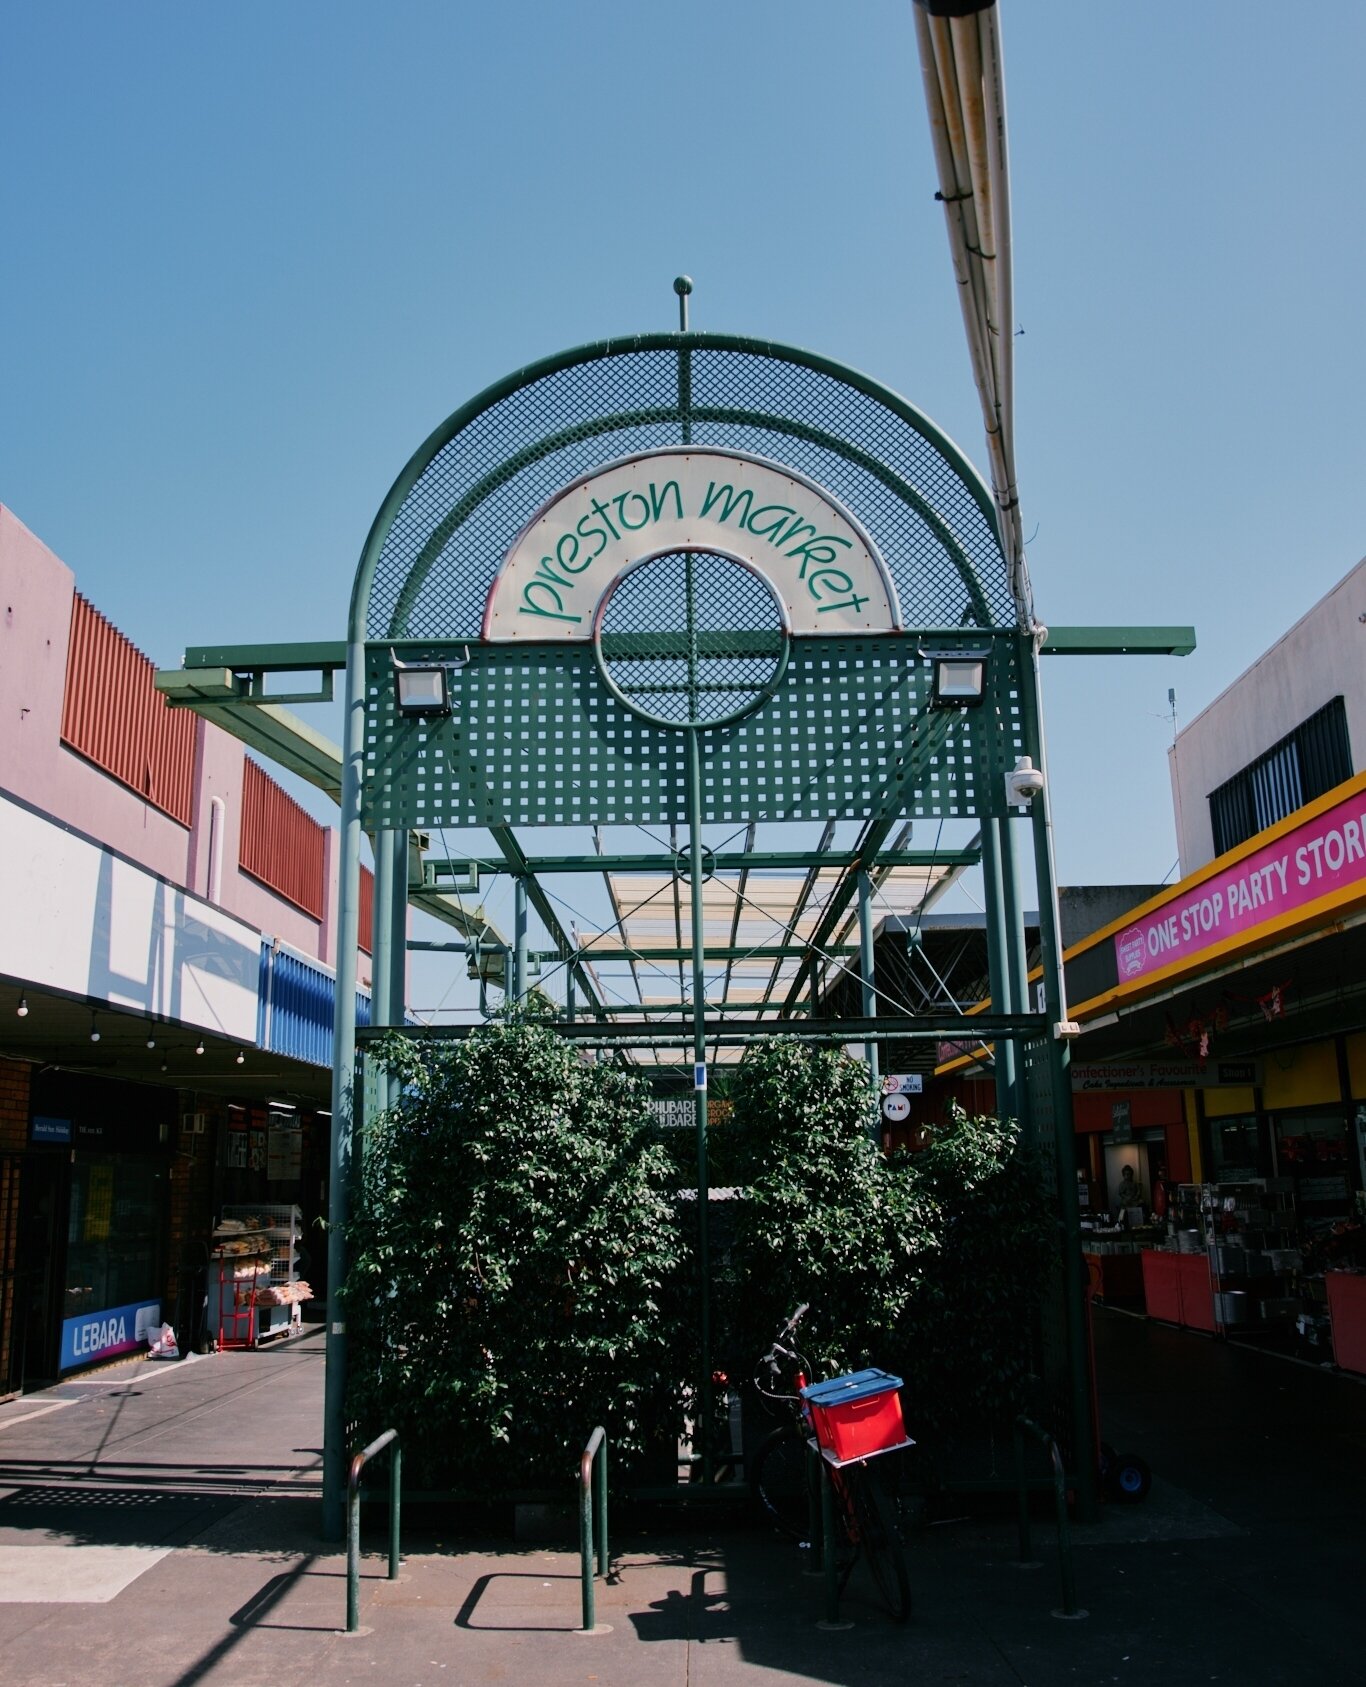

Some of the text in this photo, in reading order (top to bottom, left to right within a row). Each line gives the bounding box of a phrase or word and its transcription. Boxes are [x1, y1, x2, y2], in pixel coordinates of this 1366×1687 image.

[518, 480, 870, 624] preston market
[1147, 916, 1180, 957] ONE
[1181, 891, 1223, 942] STOP
[1227, 855, 1289, 919] PARTY
[906, 1075, 914, 1083] NO
[1071, 1063, 1145, 1078] onfectioner's
[899, 1083, 921, 1091] SMOKING
[73, 1315, 126, 1357] LEBARA
